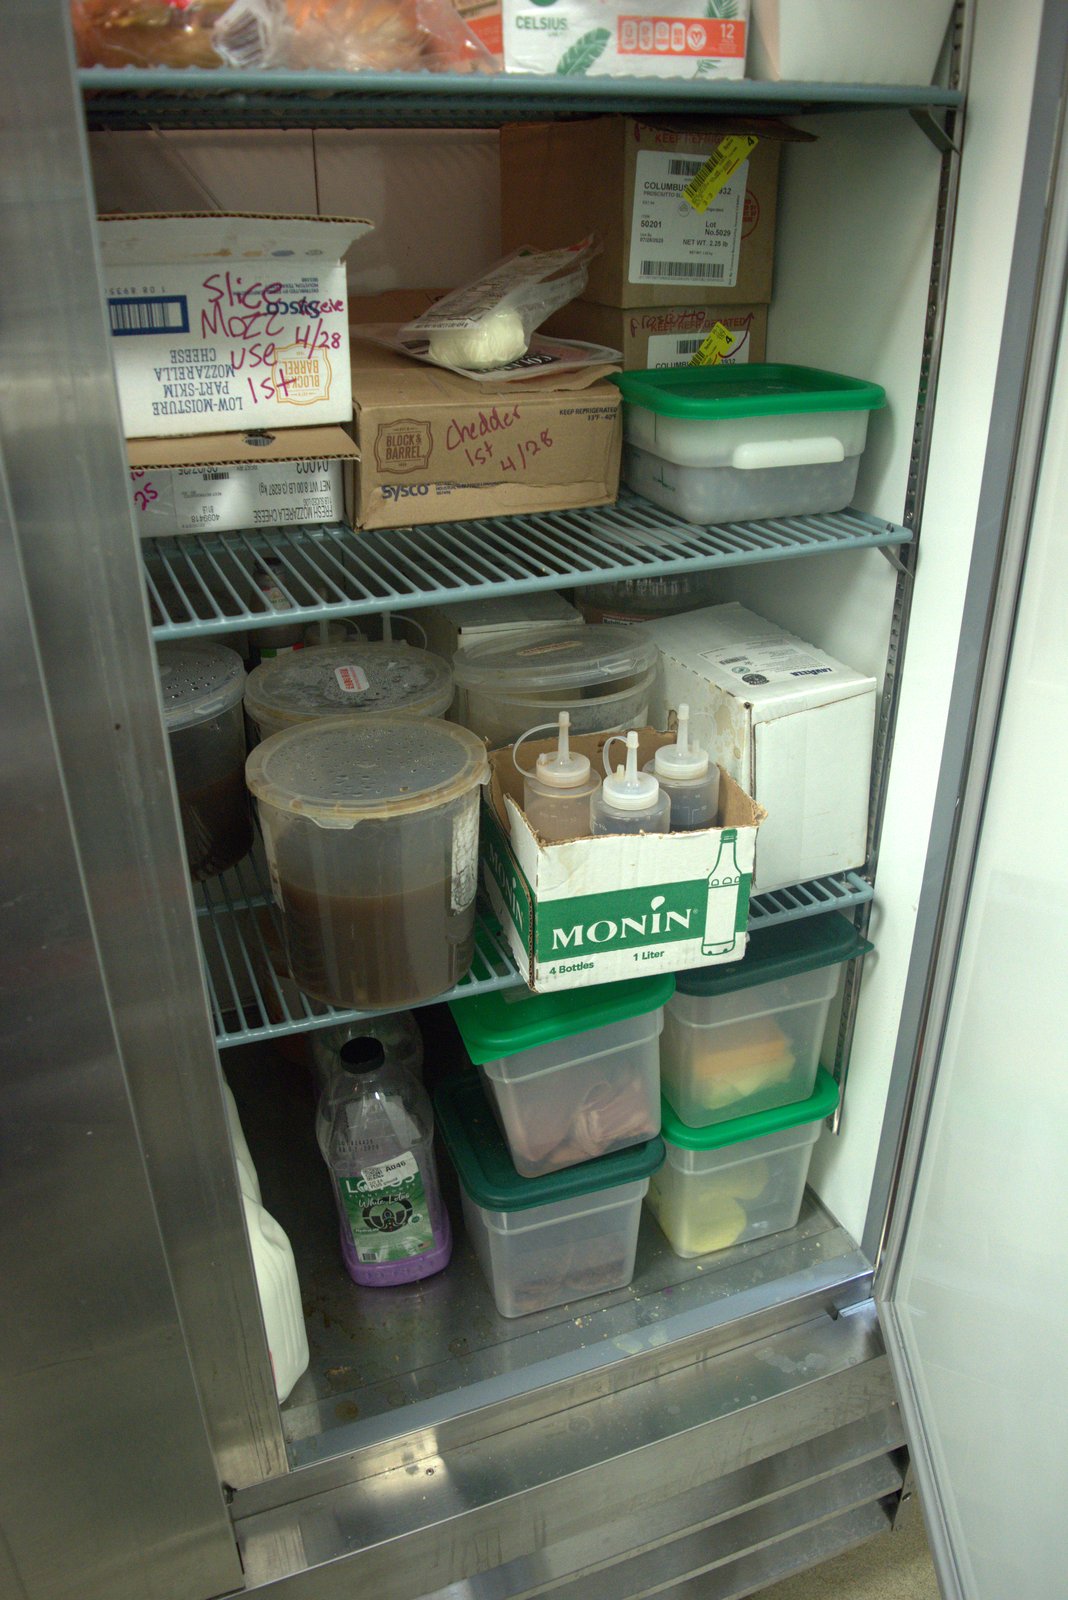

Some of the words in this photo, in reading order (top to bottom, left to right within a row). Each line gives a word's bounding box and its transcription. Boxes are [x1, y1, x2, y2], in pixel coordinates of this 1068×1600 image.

[515, 15, 568, 31] CELSIUS
[719, 23, 736, 40] 12
[644, 181, 689, 192] COLUMBUS
[640, 219, 662, 229] 50201
[705, 220, 717, 228] Lot
[704, 228, 732, 237] No.5029
[722, 240, 729, 248] lb
[202, 271, 284, 309] Slice
[295, 317, 343, 360] 4/28
[169, 347, 217, 364] CHEESE
[153, 364, 236, 382] MOZZARELLA
[281, 359, 320, 375] BARREL
[163, 380, 230, 398] PART-SKIM
[292, 375, 320, 389] BLOCK
[151, 397, 243, 416] LOW-MOISTURE
[386, 433, 415, 447] BLOCK
[415, 433, 422, 445] &
[385, 446, 423, 460] BARREL
[464, 440, 493, 467] 1st
[500, 428, 553, 471] 4/28
[309, 480, 318, 493] WT
[320, 480, 331, 492] NET
[253, 509, 279, 523] CHEESE
[314, 505, 333, 518] FRESH
[790, 667, 833, 677] LAVAZZA
[551, 895, 692, 950] MONIN
[633, 952, 638, 961] 1
[641, 949, 665, 961] Liter
[549, 965, 557, 975] 4
[558, 960, 595, 974] Bottles
[358, 1197, 385, 1209] White
